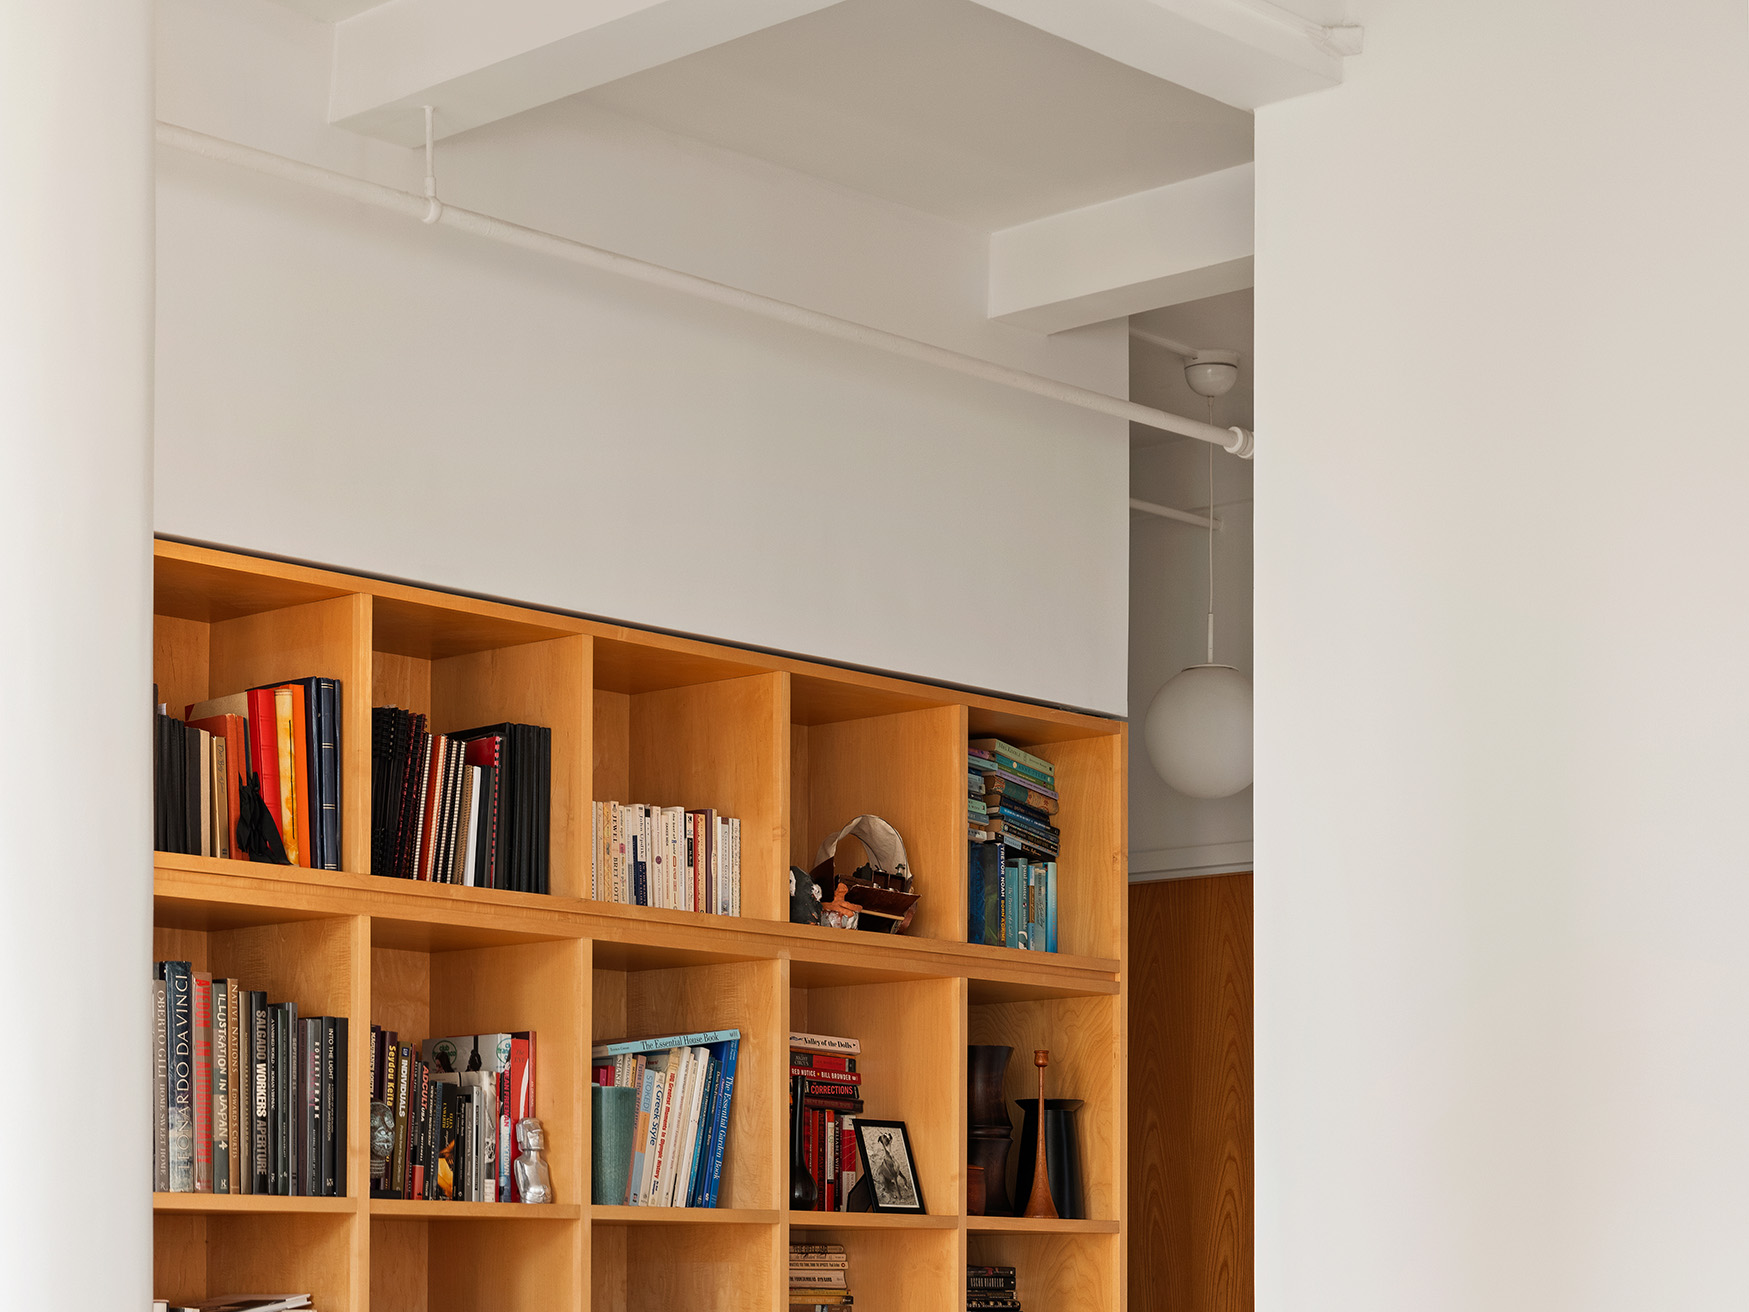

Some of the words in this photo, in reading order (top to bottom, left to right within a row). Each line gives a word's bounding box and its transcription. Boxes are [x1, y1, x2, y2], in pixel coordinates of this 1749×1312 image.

[175, 975, 189, 1025] VINCI
[195, 979, 210, 1027] AVEDON
[176, 1031, 189, 1055] DA
[196, 1040, 211, 1056] AN
[217, 994, 227, 1074] ILLUSTRATION
[256, 1010, 266, 1059] SALGADO
[640, 1041, 653, 1050] The
[654, 1038, 682, 1048] Essential
[684, 1034, 703, 1045] House
[704, 1032, 719, 1042] Book
[804, 1037, 820, 1046] Valley
[157, 1051, 166, 1078] GILI
[387, 1045, 396, 1079] Seydou
[219, 1079, 227, 1090] IN
[256, 1063, 266, 1117] WORKERS
[399, 1059, 408, 1117] INDIVIDUALS
[421, 1065, 429, 1108] ADCULT
[642, 1075, 653, 1112] STOKED!
[666, 1083, 674, 1105] Greatest
[725, 1076, 734, 1091] The
[810, 1085, 853, 1094] CORRECTIONS
[175, 1062, 189, 1169] LEONARDO
[196, 1062, 212, 1164] AUTOBIOGRAPHY
[218, 1095, 227, 1140] JAPAN
[654, 1090, 662, 1119] Greek
[662, 1106, 671, 1130] Moments
[719, 1093, 731, 1128] Essential
[219, 1140, 227, 1150] 4
[256, 1120, 266, 1175] APERTURE
[650, 1122, 660, 1146] Style
[715, 1130, 726, 1158] Garden
[655, 1159, 663, 1179] History
